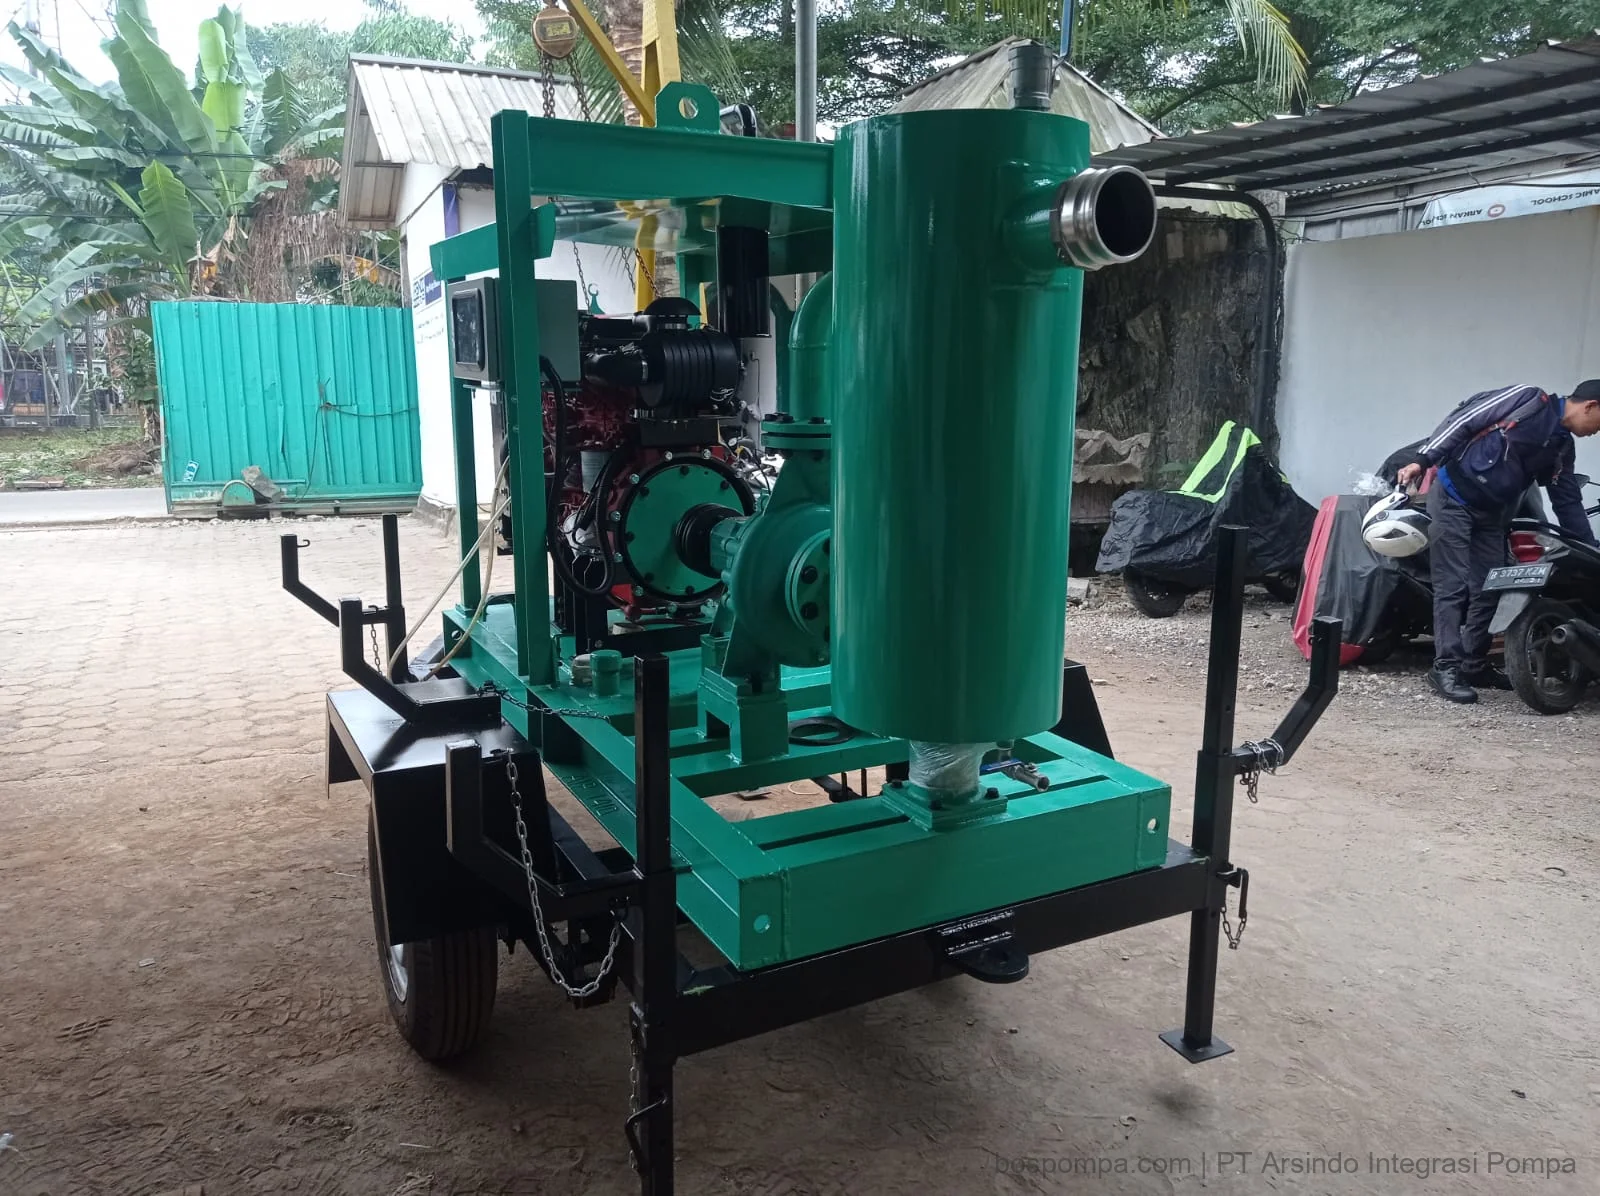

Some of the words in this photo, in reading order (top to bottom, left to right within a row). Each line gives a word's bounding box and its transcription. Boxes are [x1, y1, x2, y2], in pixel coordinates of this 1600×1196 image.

[1531, 193, 1573, 206] SCHOOL
[1450, 209, 1483, 219] ARKAN
[1490, 571, 1498, 580] B
